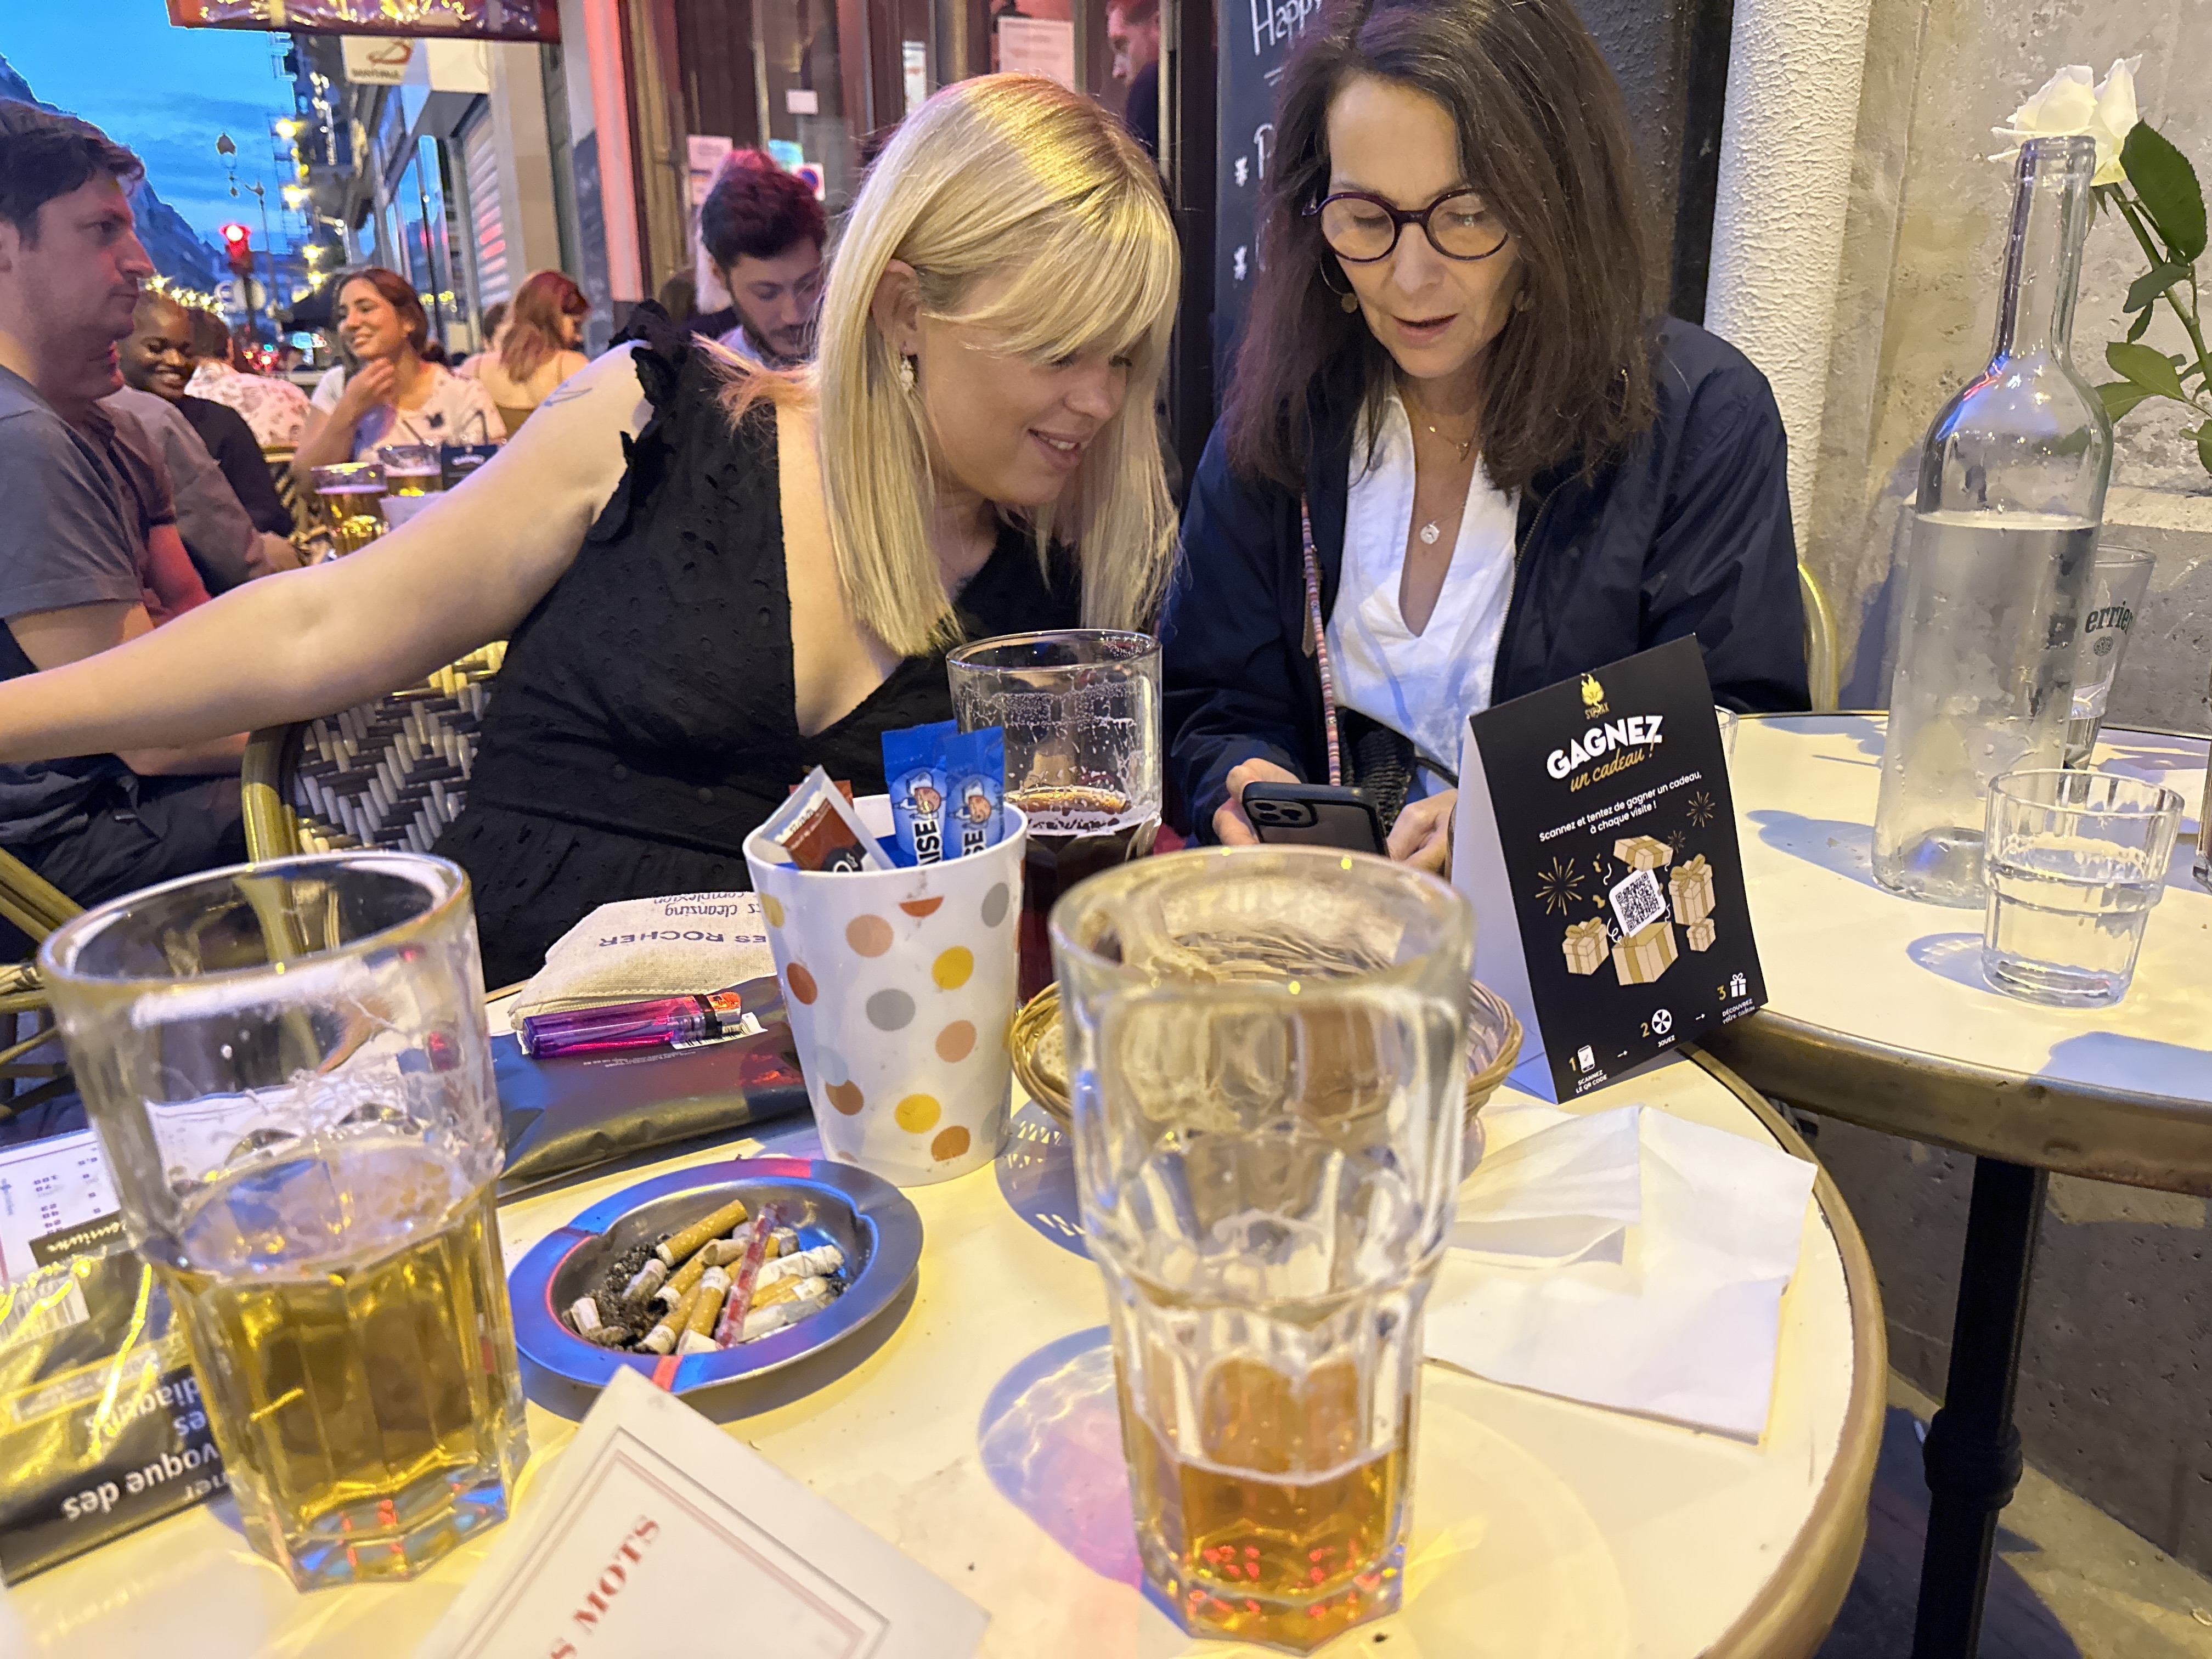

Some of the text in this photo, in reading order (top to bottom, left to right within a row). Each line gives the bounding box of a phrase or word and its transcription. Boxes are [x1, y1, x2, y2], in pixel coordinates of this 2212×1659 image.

[1250, 0, 1322, 55] Happ
[1547, 715, 1663, 779] GAGNEZ
[1570, 771, 1590, 792] un
[1593, 748, 1644, 782] cadeau
[1539, 771, 1702, 842] Scannez et tentez de gagner un cadeau,
[1590, 825, 1597, 834] à
[1598, 812, 1629, 831] chaque
[1630, 803, 1652, 818] visite
[665, 902, 738, 918] cleansing
[599, 931, 724, 947] ROCHER
[1717, 985, 1726, 1001] 3
[1640, 1022, 1650, 1038] 2
[1658, 1034, 1675, 1047] JOUEZ
[1569, 1057, 1576, 1072] 1
[1578, 1069, 1603, 1086] SCANNEZ
[1583, 1082, 1592, 1090] QR
[1592, 1074, 1607, 1086] CODE
[172, 1409, 207, 1437] es
[61, 1442, 218, 1522] voque des
[571, 1513, 660, 1636] MOTS
